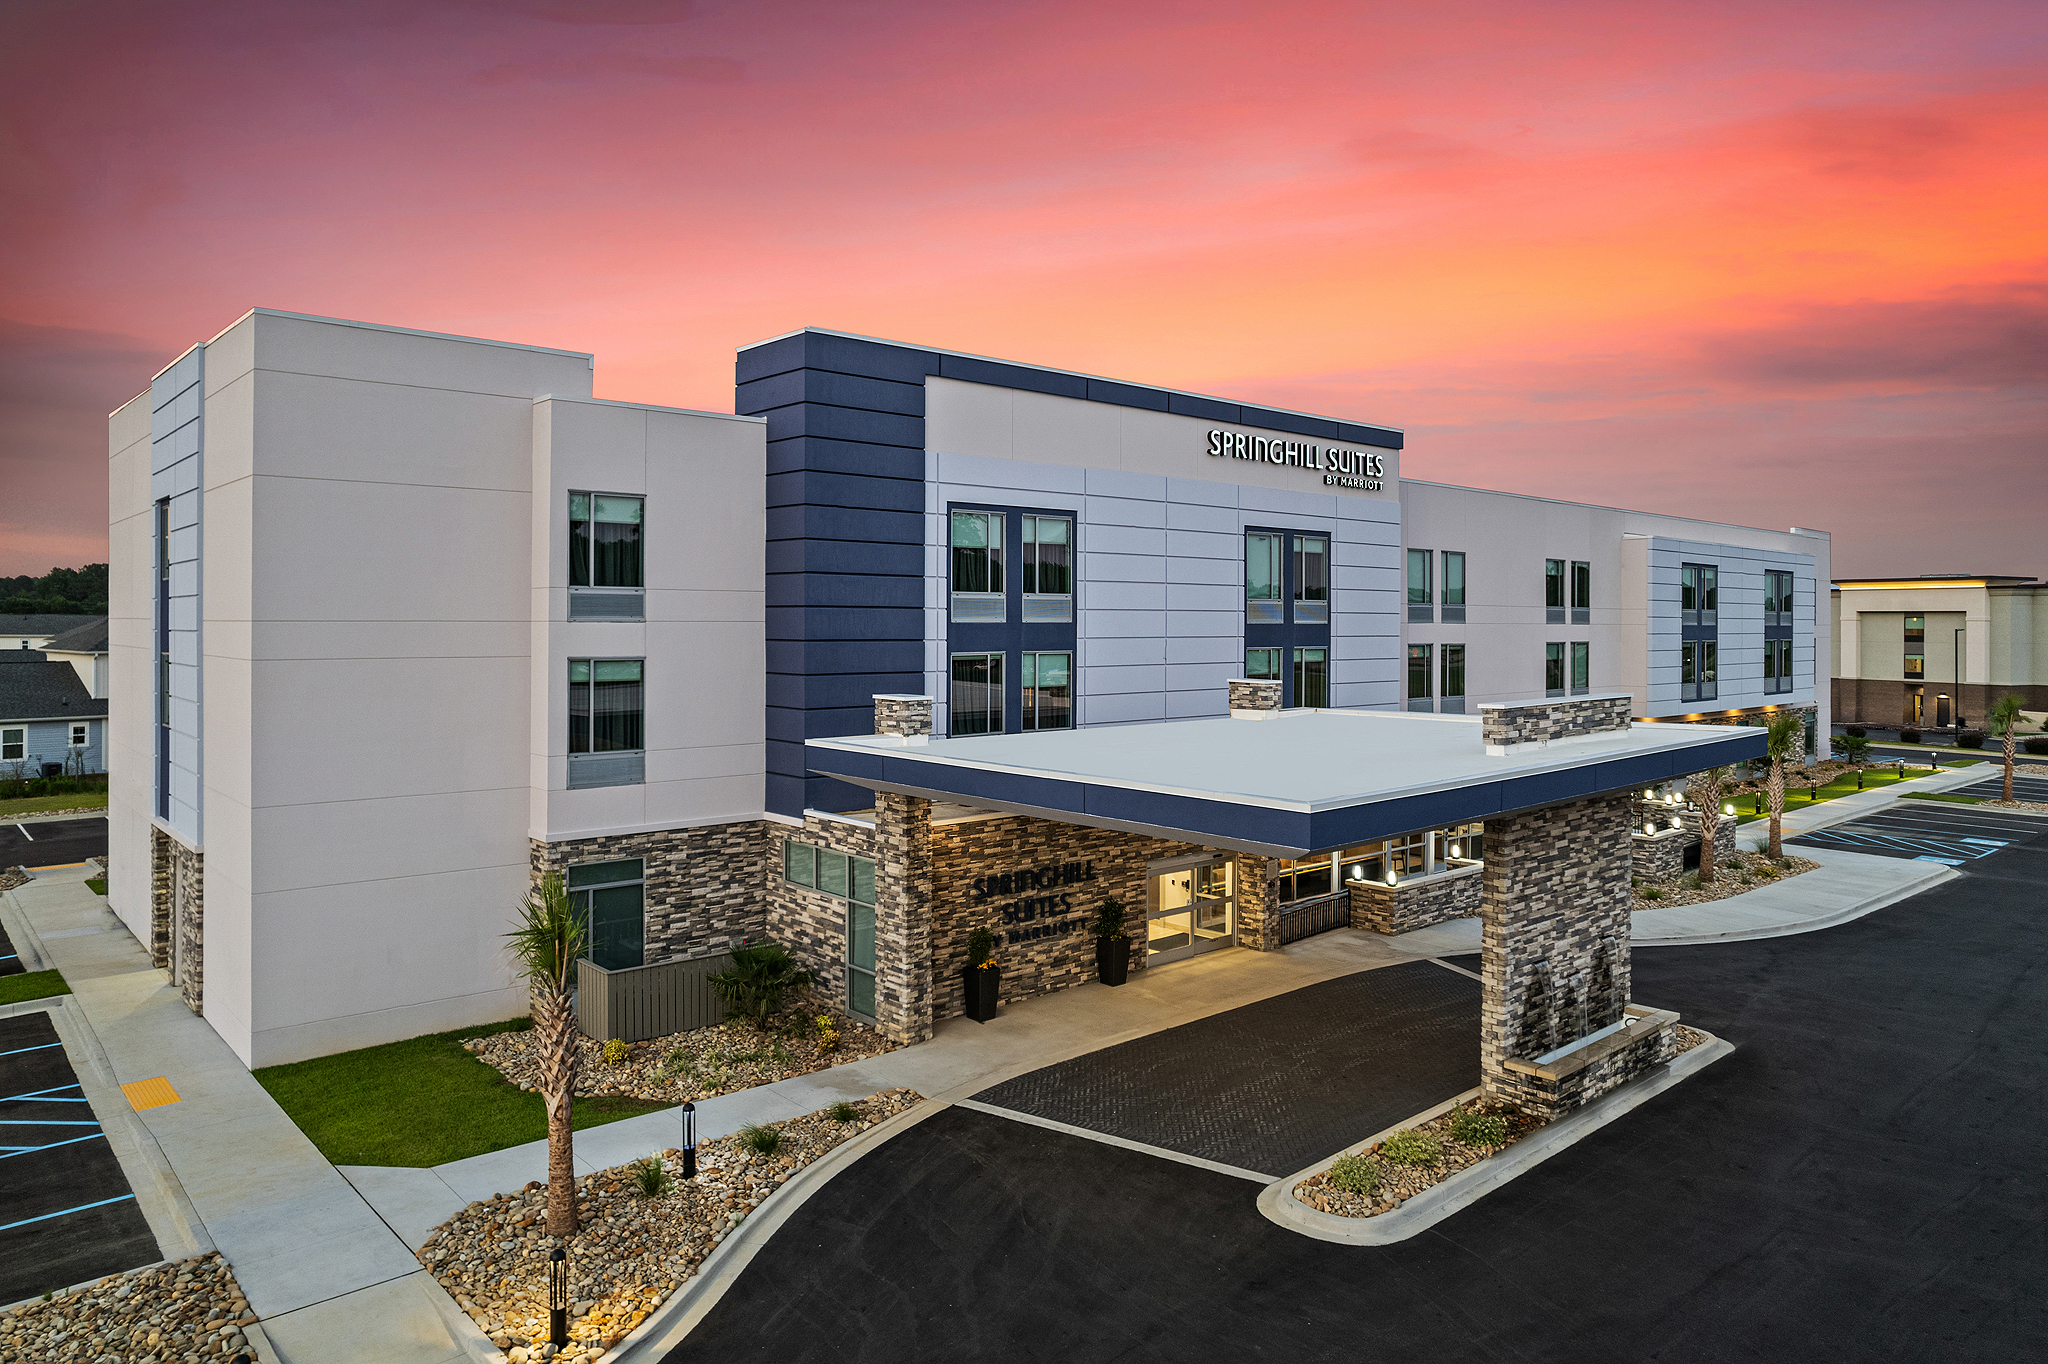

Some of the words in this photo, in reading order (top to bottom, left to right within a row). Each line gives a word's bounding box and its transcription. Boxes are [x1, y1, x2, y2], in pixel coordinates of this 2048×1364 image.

[1207, 429, 1324, 470] SPRINGHILL
[1326, 448, 1384, 478] SUITES
[1324, 474, 1338, 485] BY
[1338, 476, 1384, 491] MARRIOTT
[973, 860, 1096, 900] SPRINGHILL
[1002, 892, 1072, 925] SUITES
[1008, 917, 1088, 944] MARRIOTT
